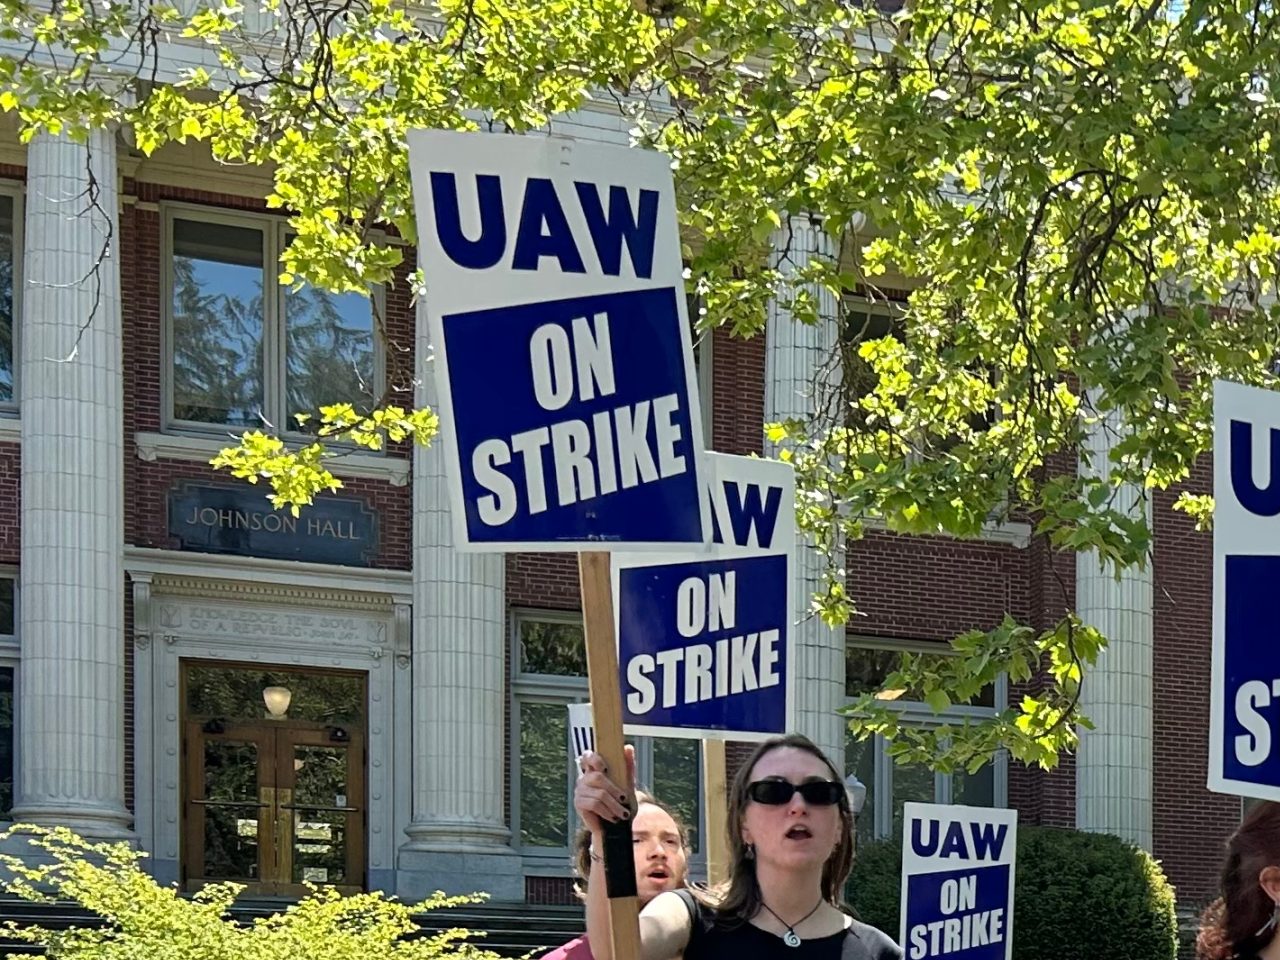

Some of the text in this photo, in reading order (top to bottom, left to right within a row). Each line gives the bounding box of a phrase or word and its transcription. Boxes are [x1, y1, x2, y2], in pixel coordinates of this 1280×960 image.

[430, 171, 660, 280] UAW
[529, 312, 616, 411] ON
[472, 393, 687, 526] STRIKE
[186, 508, 361, 541] JOHNSON HALL
[189, 619, 209, 630] OF
[676, 570, 736, 638] ON
[626, 628, 780, 715] STRIKE
[911, 818, 1009, 862] UAW
[940, 874, 977, 915] ON
[909, 907, 1004, 960] STRIKE
